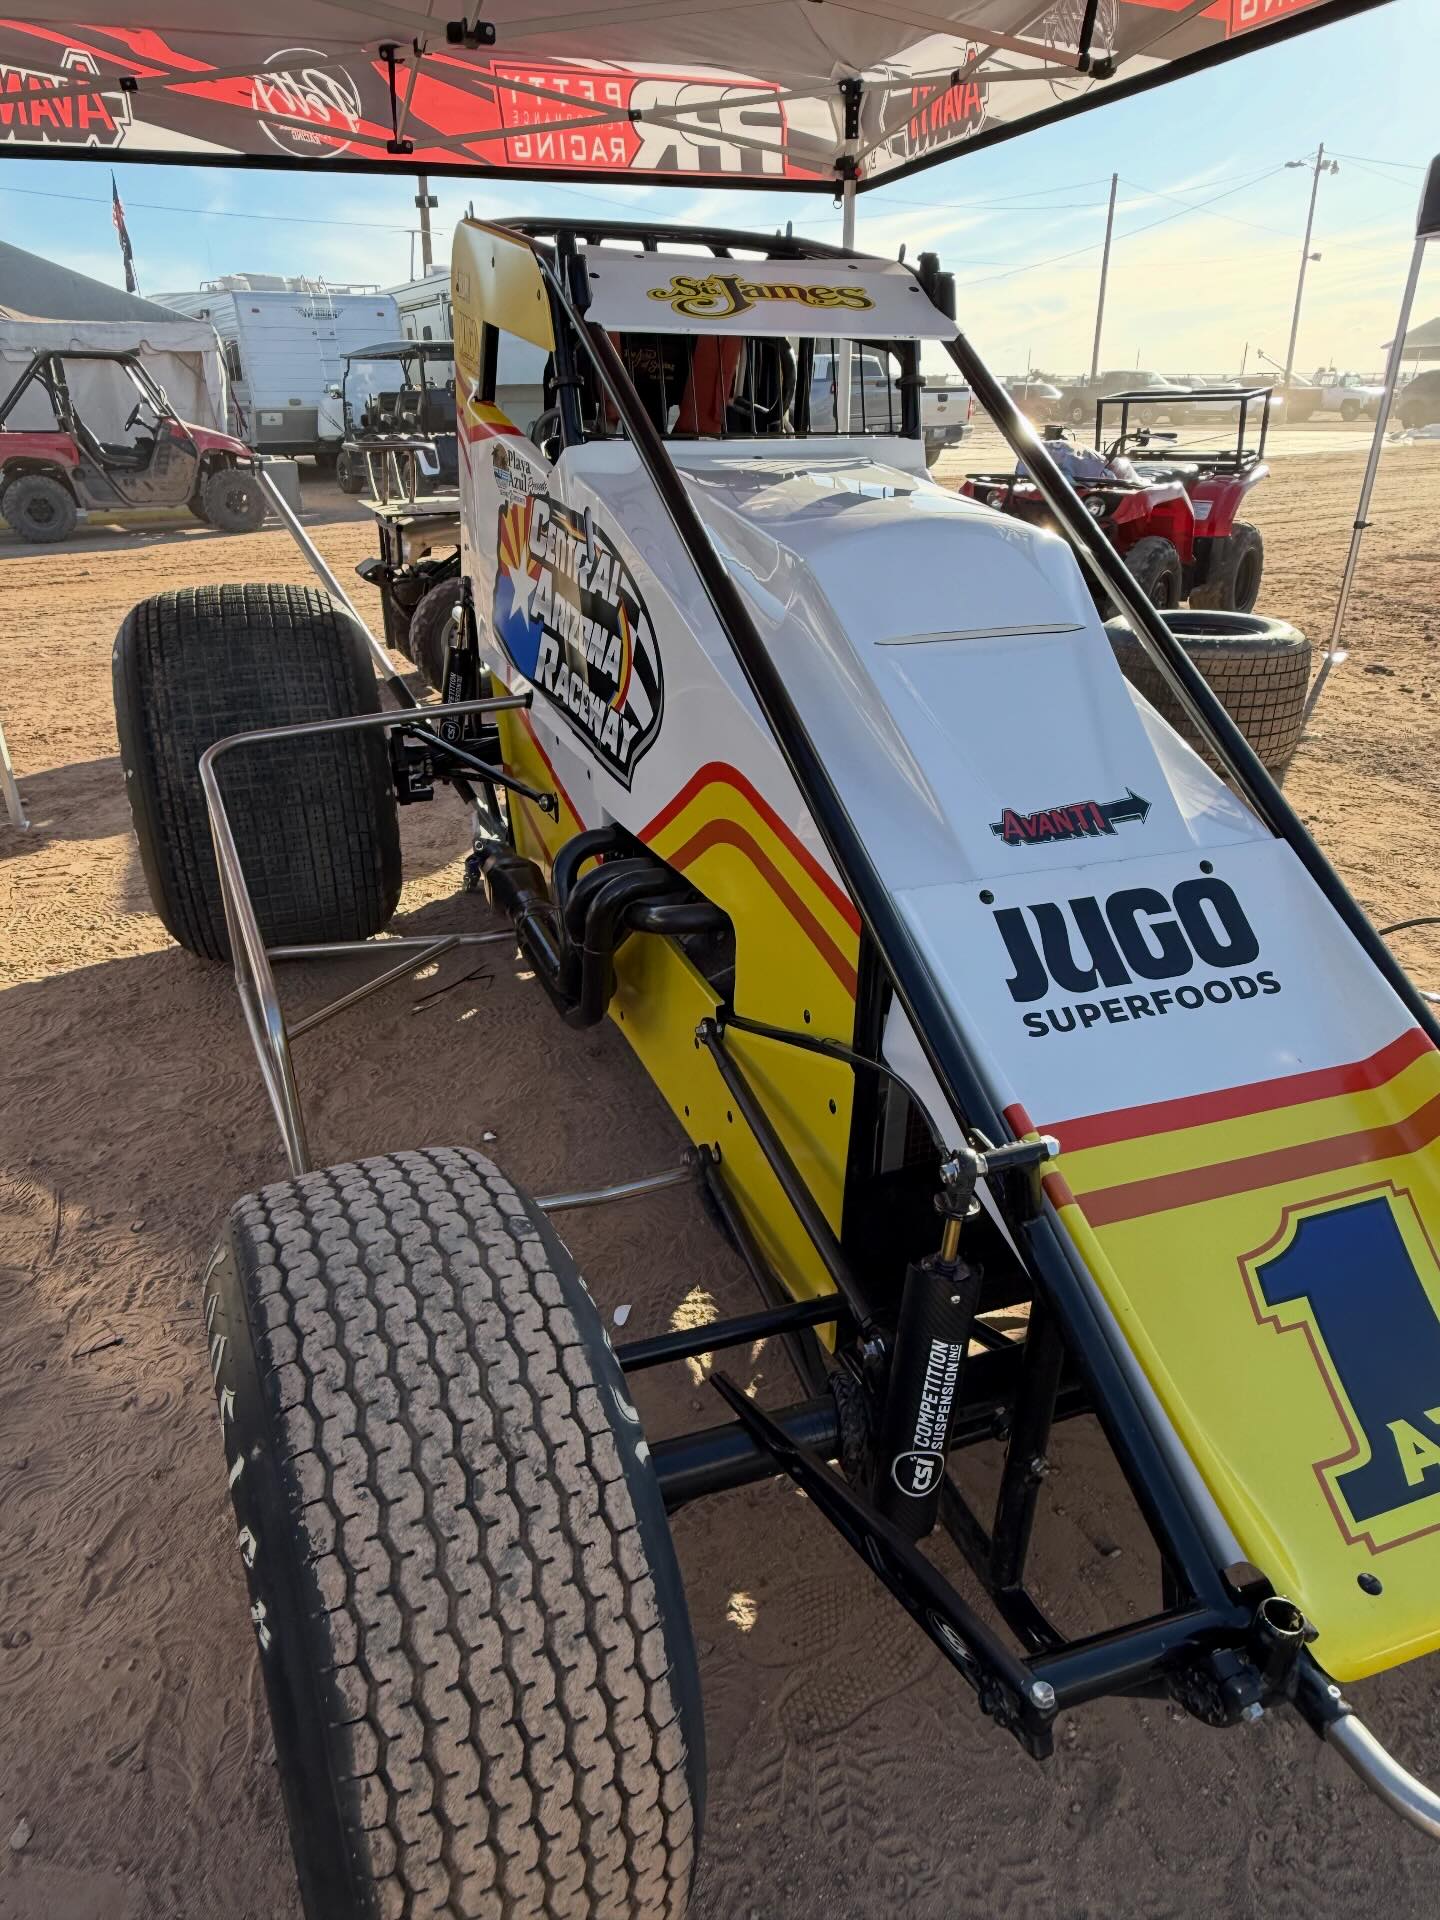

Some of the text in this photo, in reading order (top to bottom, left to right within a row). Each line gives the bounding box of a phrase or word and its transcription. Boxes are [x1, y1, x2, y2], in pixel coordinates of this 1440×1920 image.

[530, 567, 622, 685] ARIZONA
[534, 632, 640, 763] RACEWAY
[1003, 801, 1106, 840] AVANTI
[992, 877, 1260, 1002] JUGO
[1023, 971, 1282, 1037] SUPERFOODS
[913, 1339, 949, 1448] COMPETITION
[931, 1344, 962, 1450] SUSPENSION INC
[1255, 1195, 1440, 1524] 1
[1386, 1406, 1440, 1487] A
